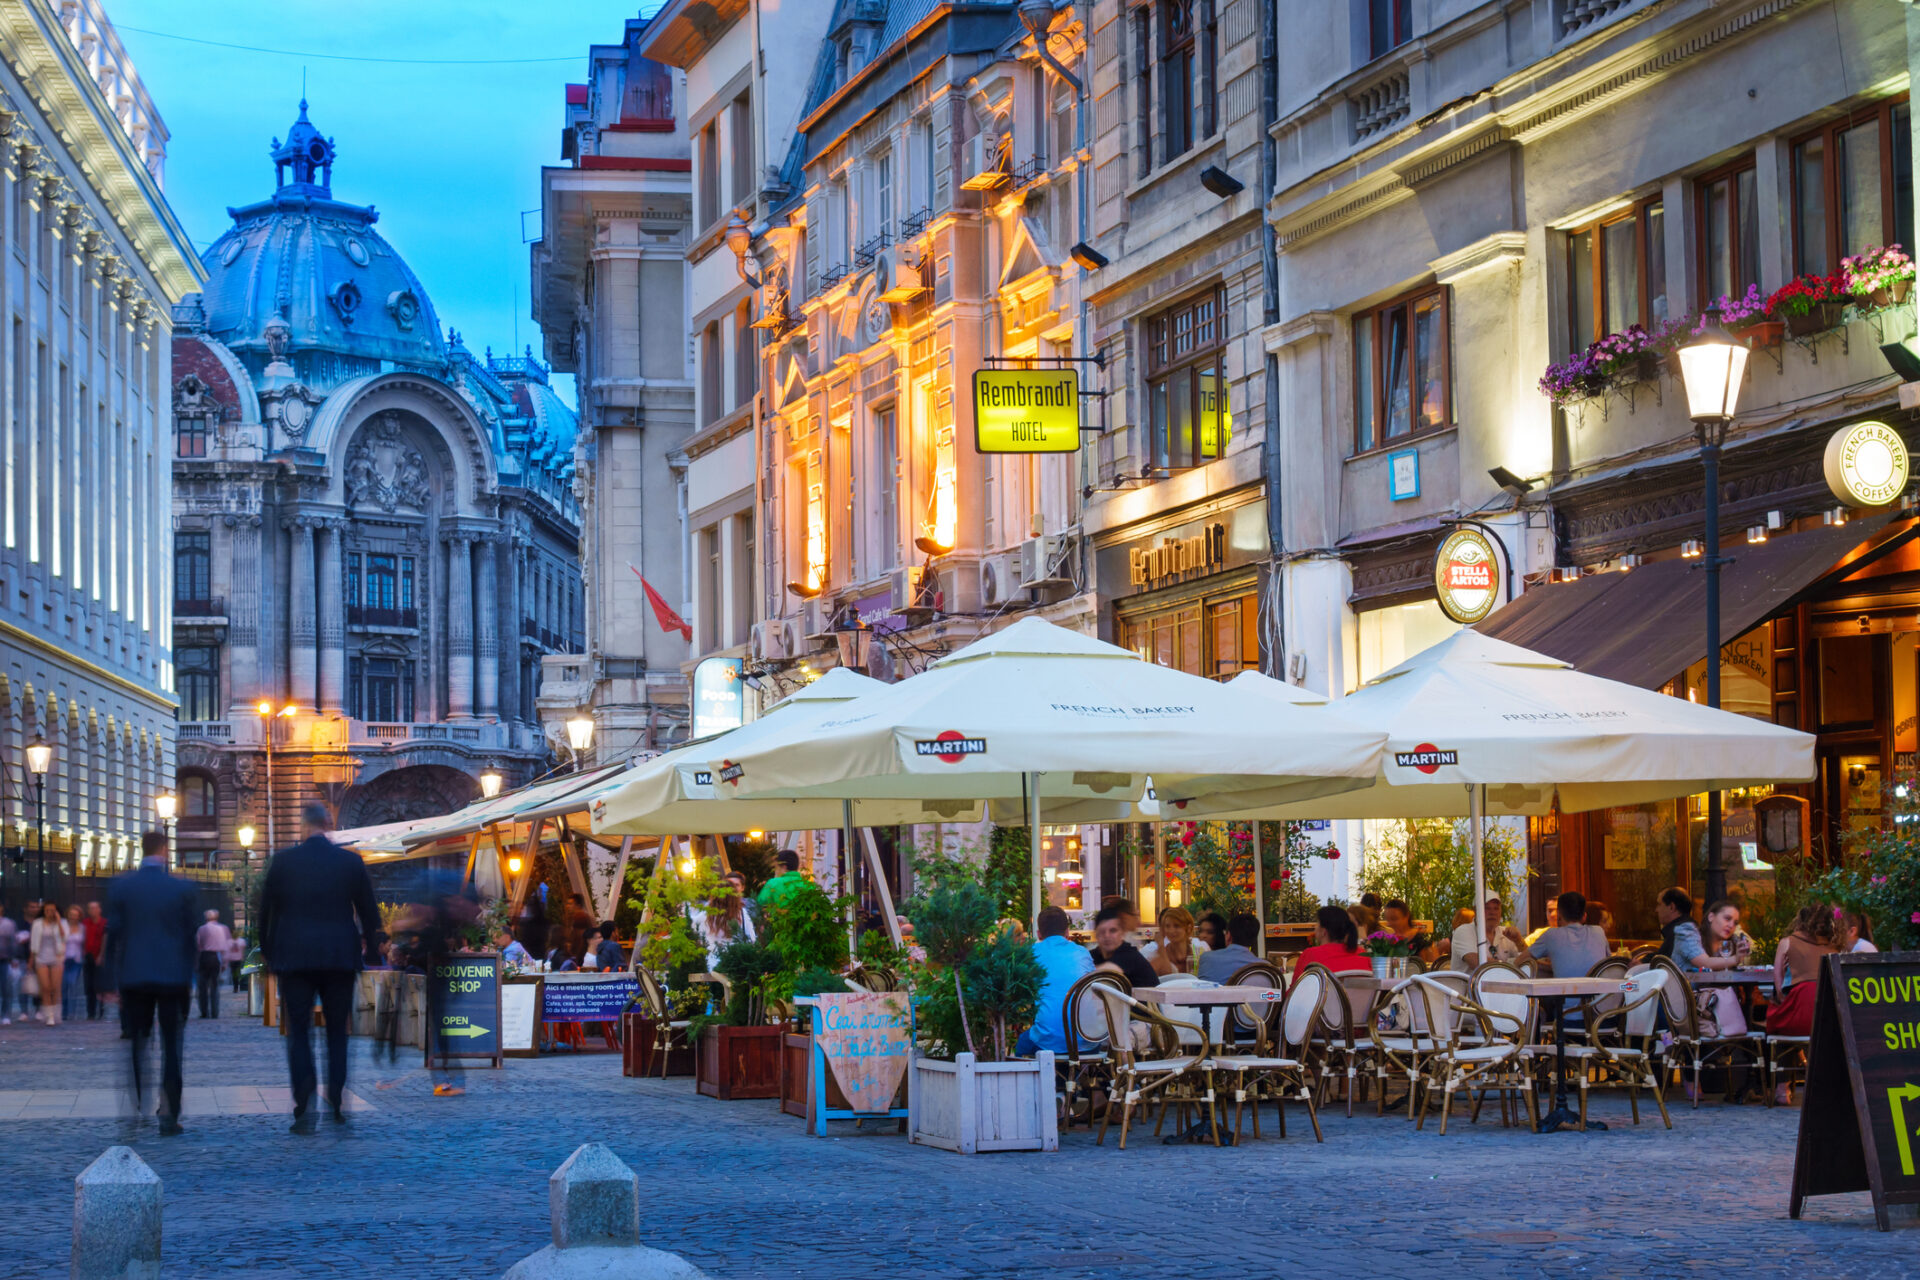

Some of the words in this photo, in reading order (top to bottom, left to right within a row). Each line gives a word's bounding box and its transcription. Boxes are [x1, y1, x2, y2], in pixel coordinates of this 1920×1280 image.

[1011, 421, 1047, 441] HOTEL
[1845, 428, 1873, 468] FRENCH
[1877, 429, 1903, 470] BAKERY
[1854, 482, 1896, 499] COFFEE
[1451, 566, 1488, 576] STELLA
[1451, 575, 1489, 586] ARTOIS
[1720, 640, 1763, 657] NCH
[1697, 656, 1730, 687] FRCH
[1733, 655, 1767, 677] BAKERY
[702, 690, 736, 701] FOOD
[1050, 704, 1126, 714] FRENCH
[1131, 706, 1195, 714] BAKERY
[1502, 711, 1572, 721] FRENCH
[917, 740, 984, 755] MARTINI
[1398, 752, 1455, 765] MARTINI
[1722, 820, 1755, 838] NDWICH
[436, 965, 493, 977] SOUVENIR
[449, 981, 481, 992] SHOP
[566, 984, 594, 992] meeting
[442, 1016, 468, 1025] OPEN
[825, 1005, 858, 1030] Ceai
